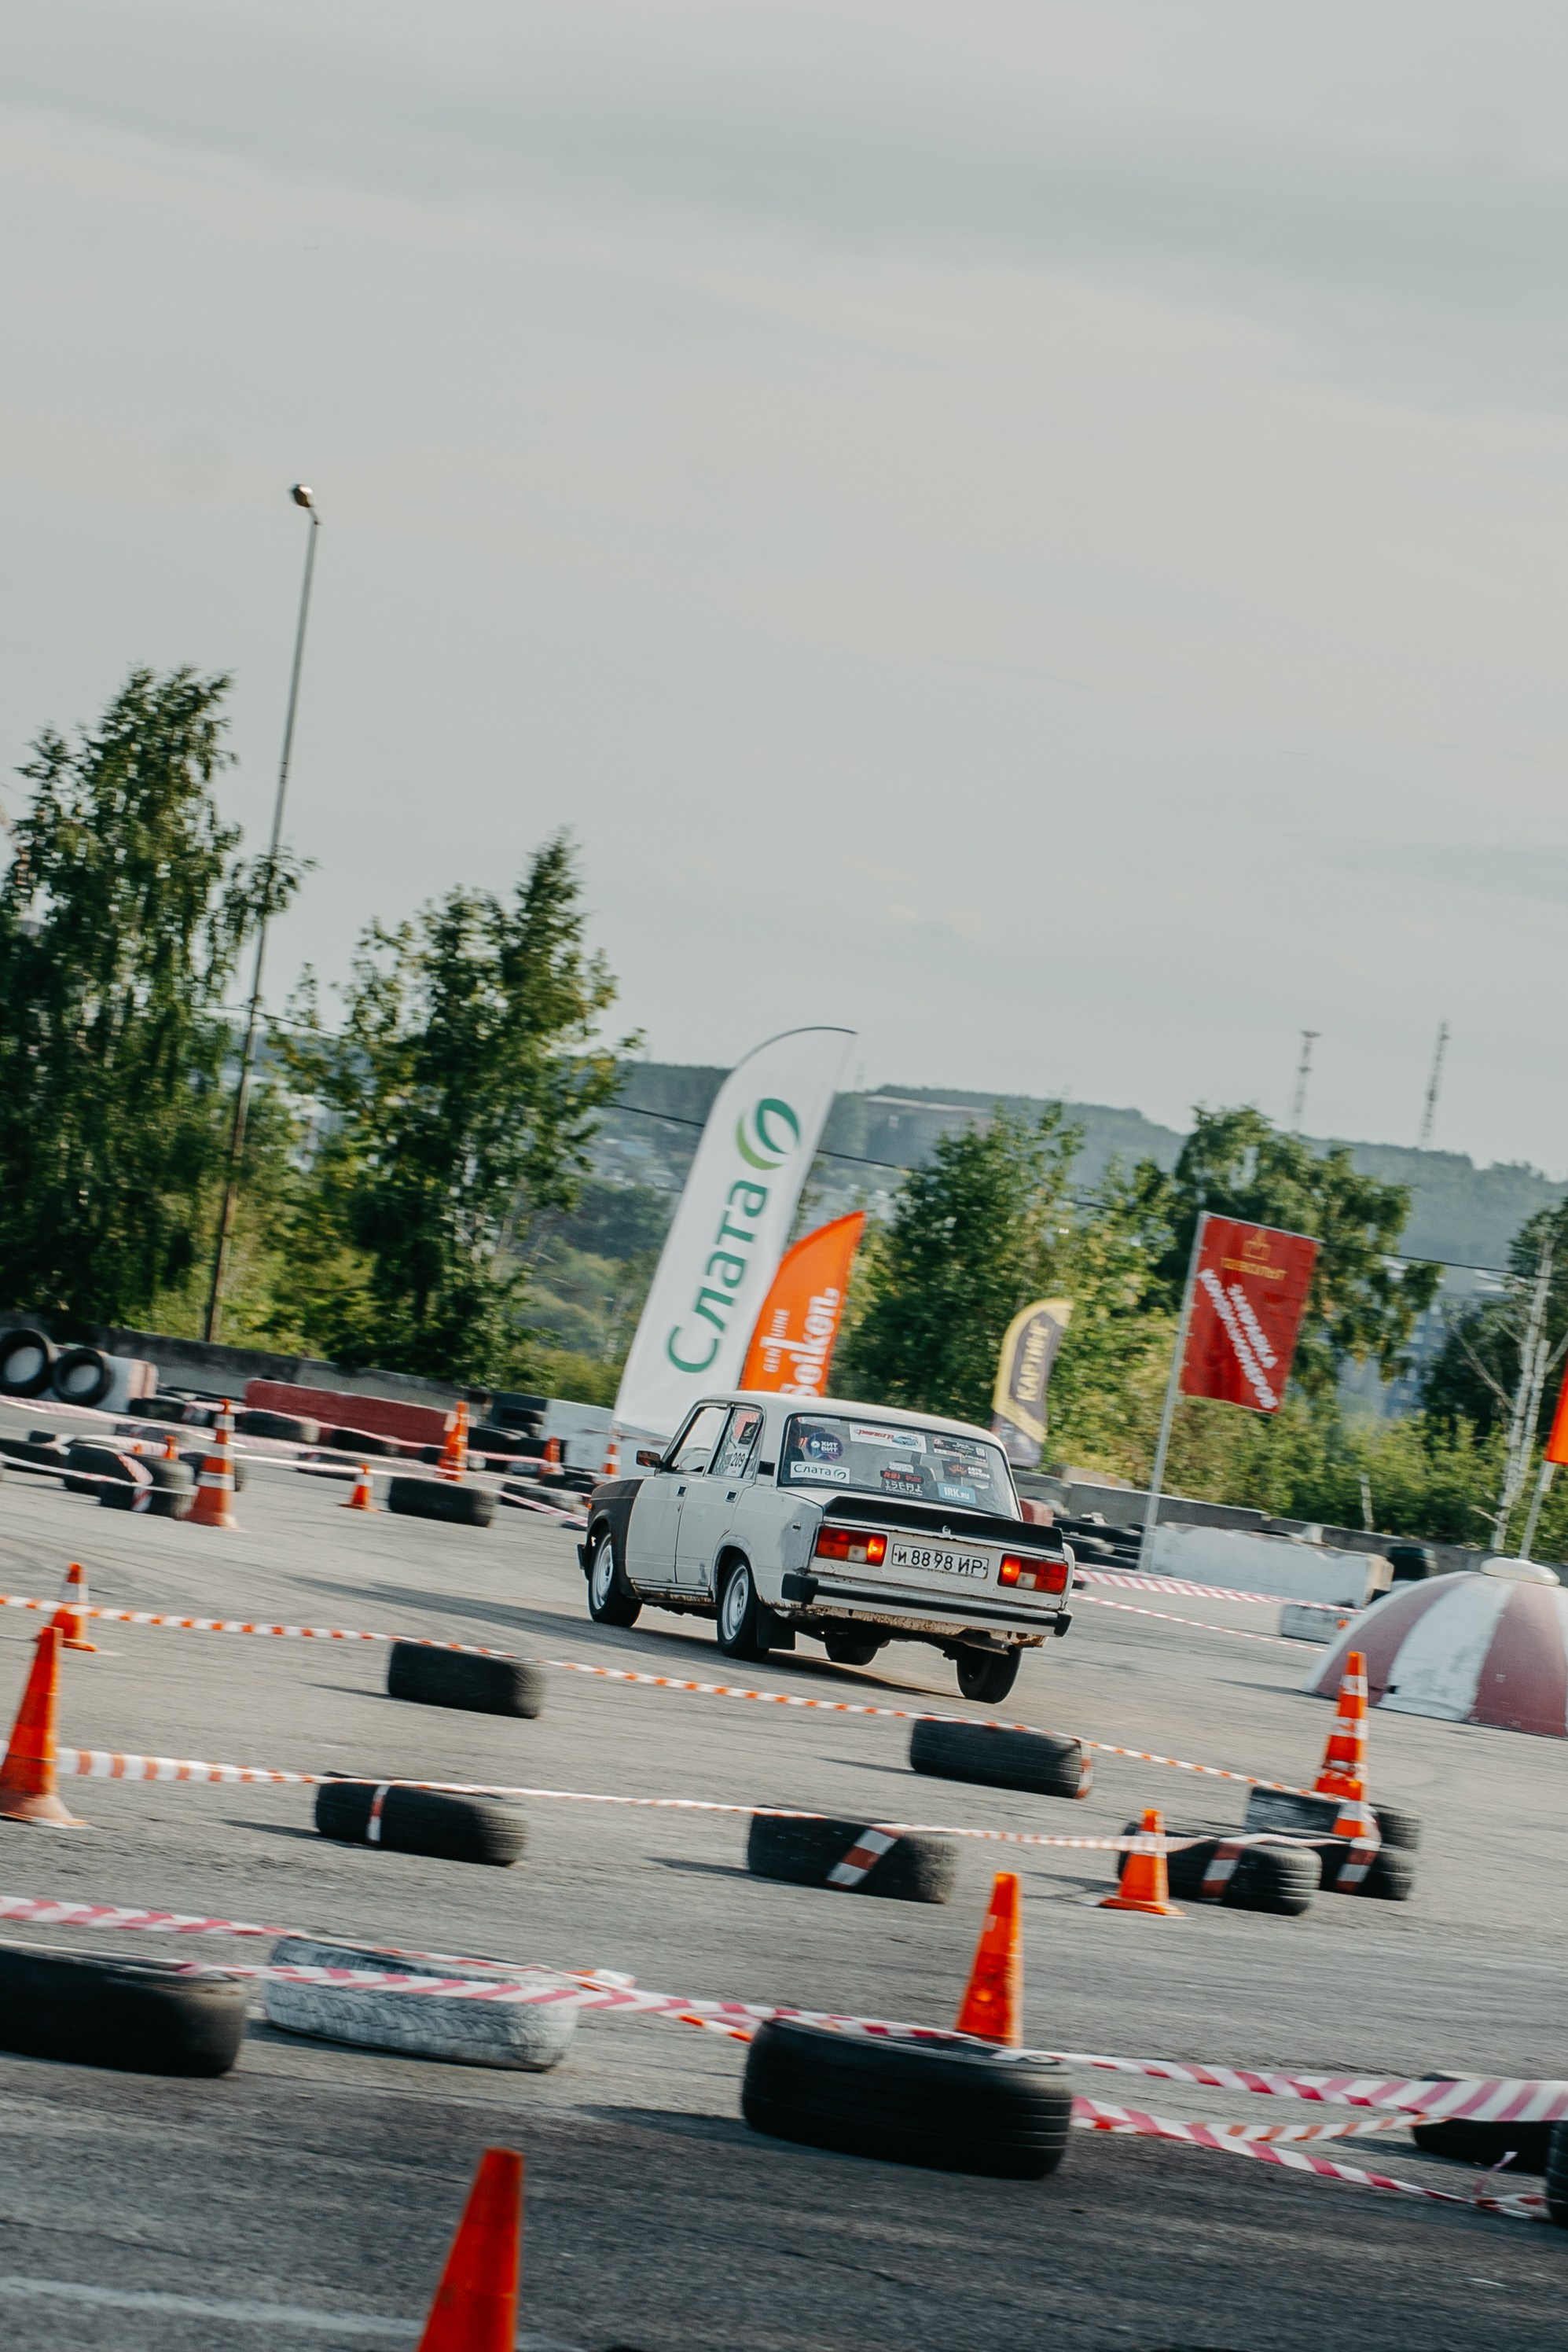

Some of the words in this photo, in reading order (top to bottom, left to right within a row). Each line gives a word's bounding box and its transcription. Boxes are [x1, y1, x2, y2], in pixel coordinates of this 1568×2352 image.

[666, 1180, 770, 1373] Слата
[730, 1452, 746, 1468] 209
[794, 1464, 832, 1476] Слата
[911, 1549, 953, 1571] 8898
[958, 1556, 983, 1574] ИР
